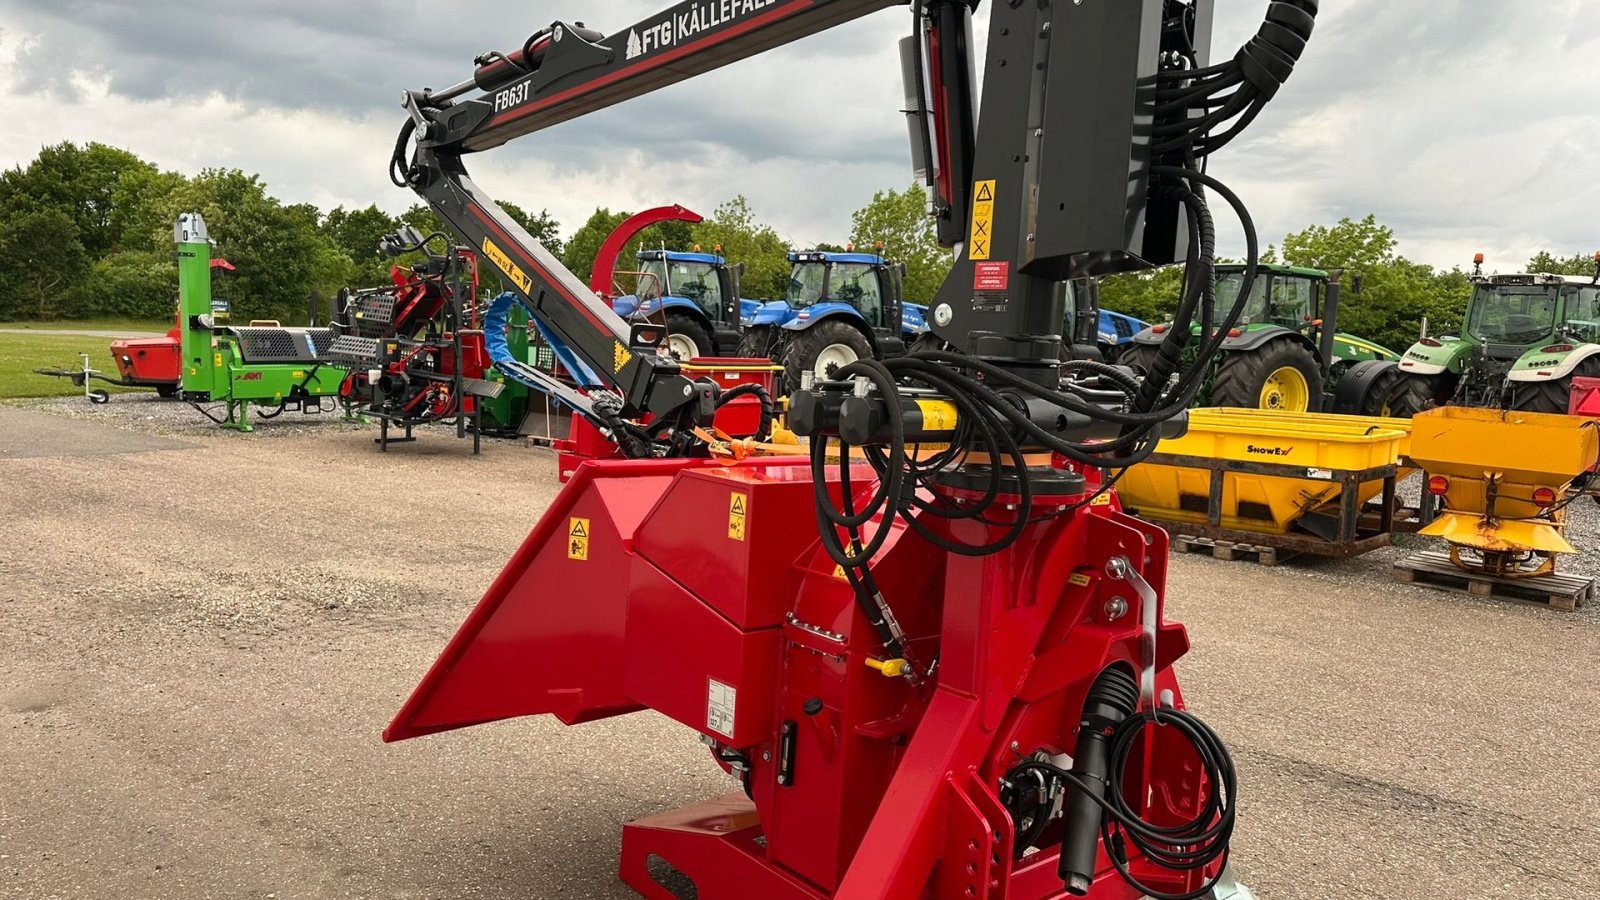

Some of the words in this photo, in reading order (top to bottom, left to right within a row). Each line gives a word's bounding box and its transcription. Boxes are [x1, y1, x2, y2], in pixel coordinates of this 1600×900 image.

[642, 20, 672, 54] FTG
[678, 0, 776, 40] KÄLLEFAL
[494, 79, 532, 113] FB63T
